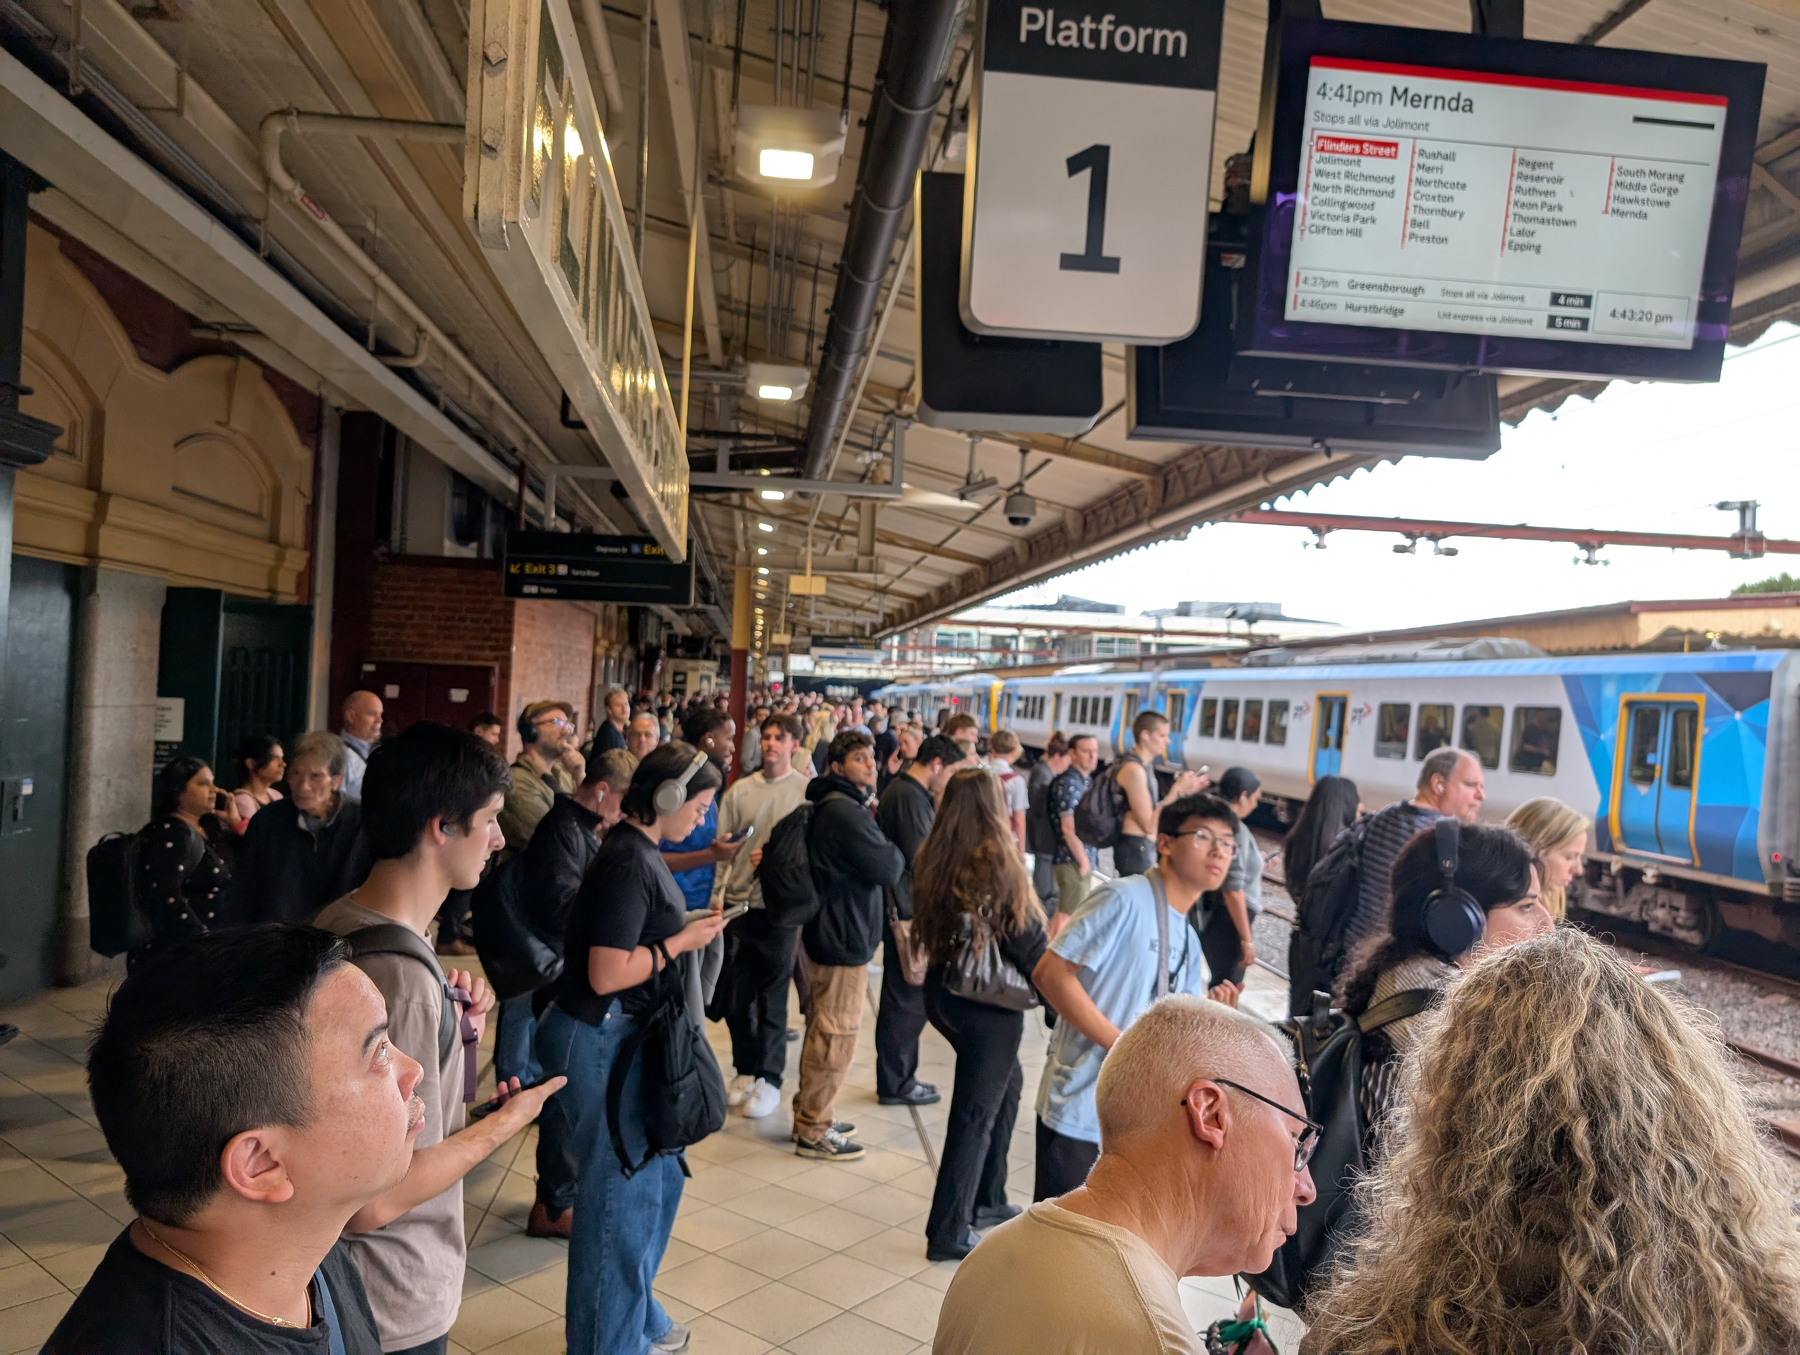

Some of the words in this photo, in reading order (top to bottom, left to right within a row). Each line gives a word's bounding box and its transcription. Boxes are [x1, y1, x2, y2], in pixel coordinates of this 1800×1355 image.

[1019, 6, 1188, 58] Platform
[1316, 82, 1383, 108] 4:41pm
[1390, 86, 1474, 114] Mernda
[1313, 110, 1345, 125] Stops
[1348, 114, 1361, 126] all
[1364, 116, 1379, 128] via
[1382, 118, 1430, 132] Jolimont
[1317, 138, 1361, 154] Flinders
[1362, 143, 1397, 157] Street
[1316, 155, 1362, 167] Jolimont
[1418, 149, 1456, 162] Rushall
[1416, 164, 1444, 175] Merri
[1517, 157, 1554, 171] Regent
[1314, 169, 1342, 180] West
[1344, 171, 1395, 184] Richmond
[1516, 171, 1564, 185] Reservoir
[1617, 166, 1646, 179] South
[1648, 169, 1685, 184] Morang
[1312, 183, 1342, 194] North
[1344, 185, 1395, 199] Richmond
[1414, 177, 1467, 191] Northcote
[1615, 181, 1647, 193] Middle
[1650, 184, 1679, 196] Gorge
[1413, 191, 1454, 203] Croxton
[1515, 185, 1556, 198] Ruthven
[1311, 196, 1375, 211] Collingwood
[1513, 199, 1538, 210] Keon
[1540, 202, 1564, 213] Park
[1613, 194, 1670, 208] Hawkstowe
[1059, 143, 1121, 274] 1
[1413, 205, 1465, 221] Thornbury
[1611, 208, 1648, 220] Mernda
[1310, 211, 1350, 223] Victoria
[1353, 213, 1377, 225] Park
[1410, 219, 1430, 229] Bell
[1512, 213, 1577, 227] Thomastown
[1308, 224, 1344, 236] Clifton
[1346, 227, 1363, 237] Hill
[1509, 227, 1536, 238] Lalor
[1408, 232, 1449, 246] Preston
[1508, 241, 1542, 254] Epping
[1347, 278, 1425, 296] Greensborough
[1441, 288, 1463, 298] Stops
[1465, 289, 1475, 299] all
[1477, 291, 1488, 300] via
[1490, 292, 1525, 303] Jolimont
[1558, 295, 1565, 305] 4
[1566, 295, 1584, 306] min
[1345, 301, 1405, 318] Hurstbridge
[1609, 308, 1653, 322] 4:43:20
[1655, 313, 1673, 324] pm
[1449, 312, 1483, 323] express
[1484, 313, 1497, 323] via
[1499, 315, 1533, 326] Jolimont
[1563, 318, 1581, 329] min
[524, 562, 546, 574] Exit
[548, 564, 556, 575] 3
